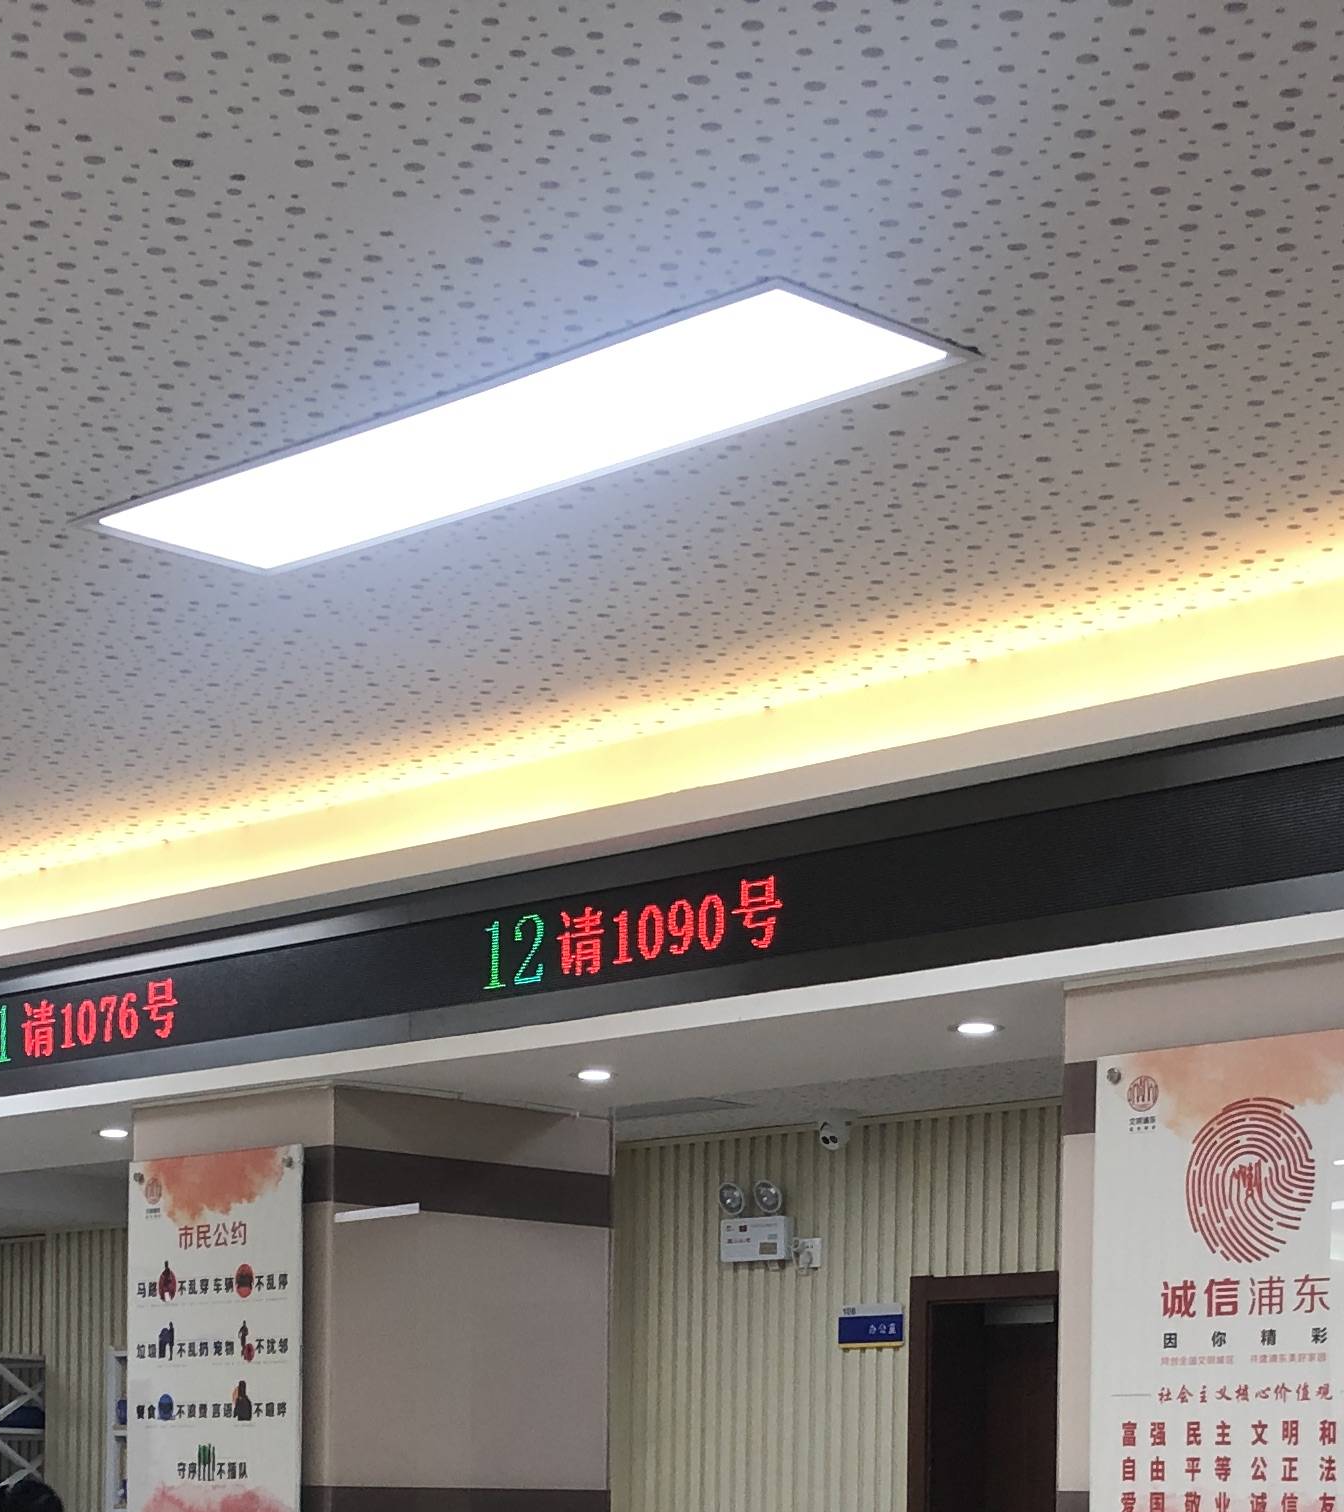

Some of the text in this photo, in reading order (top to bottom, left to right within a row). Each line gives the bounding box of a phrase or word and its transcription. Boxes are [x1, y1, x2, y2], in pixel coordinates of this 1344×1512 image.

[486, 878, 783, 992] 12 请1090号
[23, 980, 177, 1057] 请1076号
[178, 1221, 247, 1249] 市民公约
[1160, 1274, 1331, 1318] 诚信浦东
[1163, 1327, 1327, 1348] 因你精彩
[1157, 1383, 1333, 1404] 社会主义核心价值观
